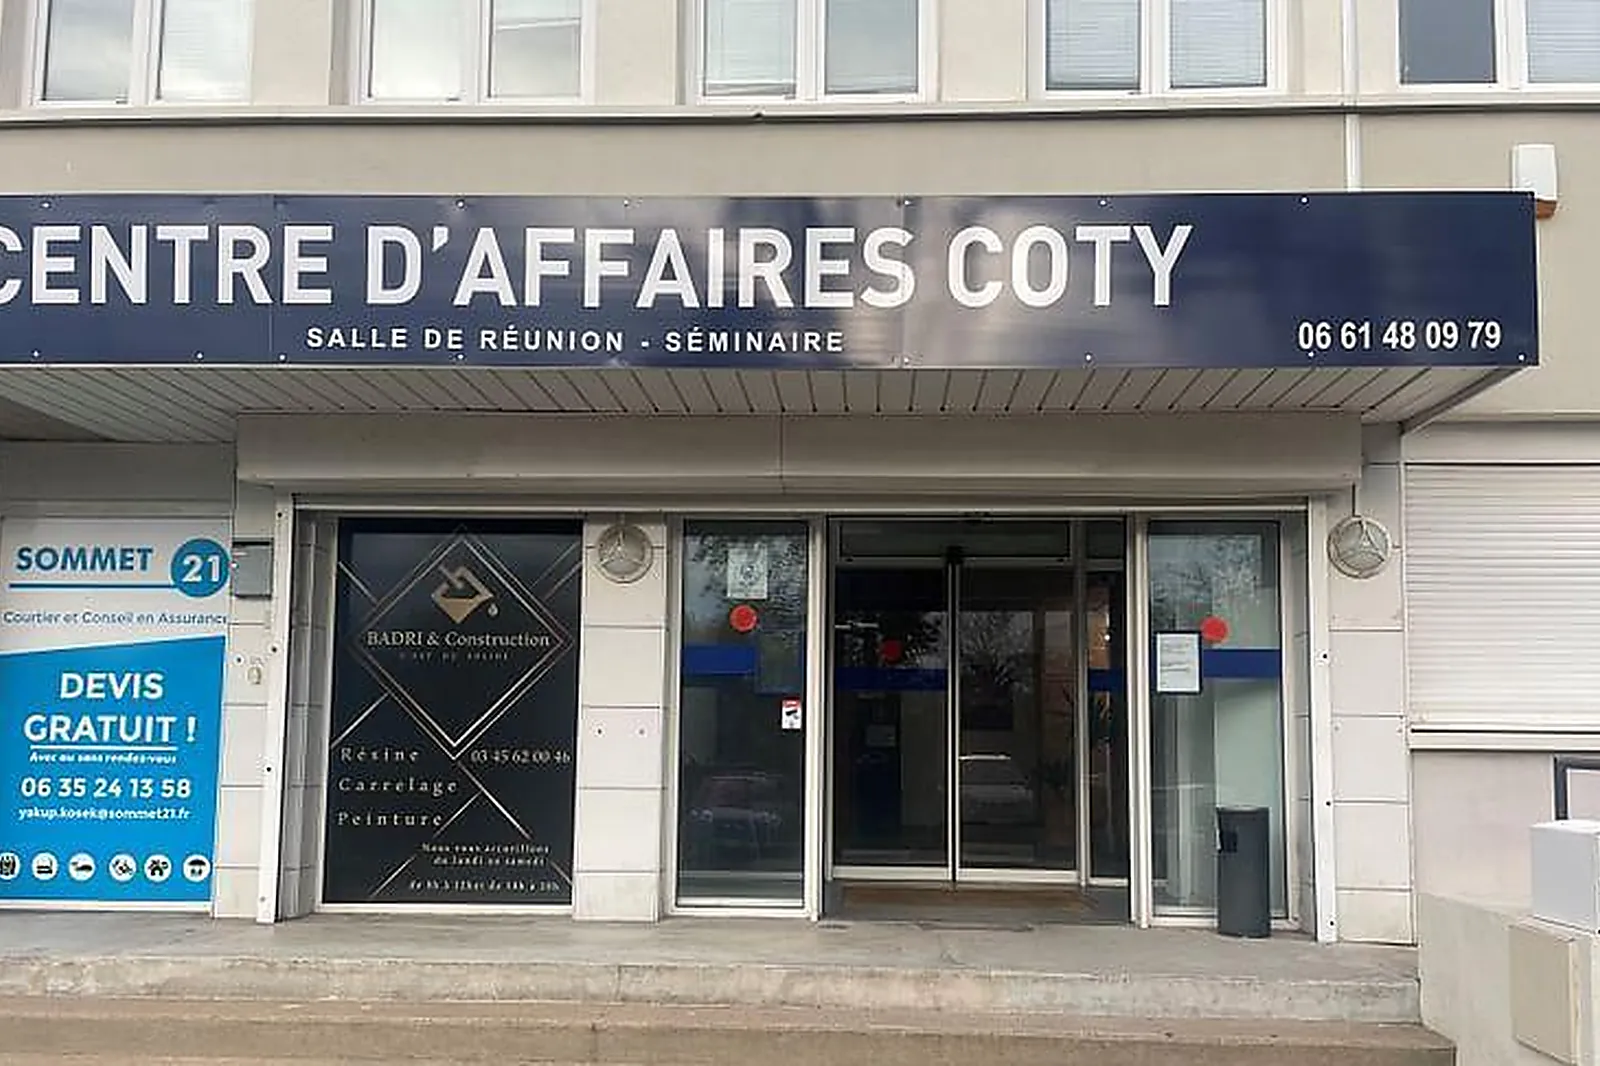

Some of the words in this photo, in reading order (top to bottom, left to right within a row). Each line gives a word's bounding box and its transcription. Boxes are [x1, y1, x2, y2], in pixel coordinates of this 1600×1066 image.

[366, 226, 917, 309] D'AFFAIRES
[946, 224, 1194, 309] COTY
[306, 327, 408, 351] SALLE
[424, 328, 463, 350] DE
[480, 324, 624, 353] RÉUNION
[665, 326, 845, 354] SÉMINAIRE
[1298, 321, 1332, 350] 06
[1340, 321, 1372, 350] 61
[1382, 321, 1416, 350] 48
[1425, 321, 1459, 350] 09
[1468, 321, 1502, 350] 79
[16, 546, 153, 572] SOMMET
[181, 554, 221, 583] 21
[3, 610, 61, 625] Courtier
[63, 612, 78, 625] et
[82, 610, 134, 625] Conseil
[137, 613, 155, 624] en
[367, 630, 423, 646] BADRI
[427, 631, 440, 646] &
[444, 630, 550, 647] Construction
[59, 672, 164, 700] DEVIS
[24, 714, 177, 743] GRATUIT
[186, 715, 197, 742] !
[29, 752, 56, 763] Avec
[340, 746, 420, 763] Résine
[21, 777, 52, 798] 06
[58, 777, 87, 798] 35
[93, 777, 122, 798] 24
[130, 777, 154, 798] 13
[161, 778, 191, 798] 58
[339, 777, 458, 797] Carrelage
[336, 811, 443, 827] Peinture
